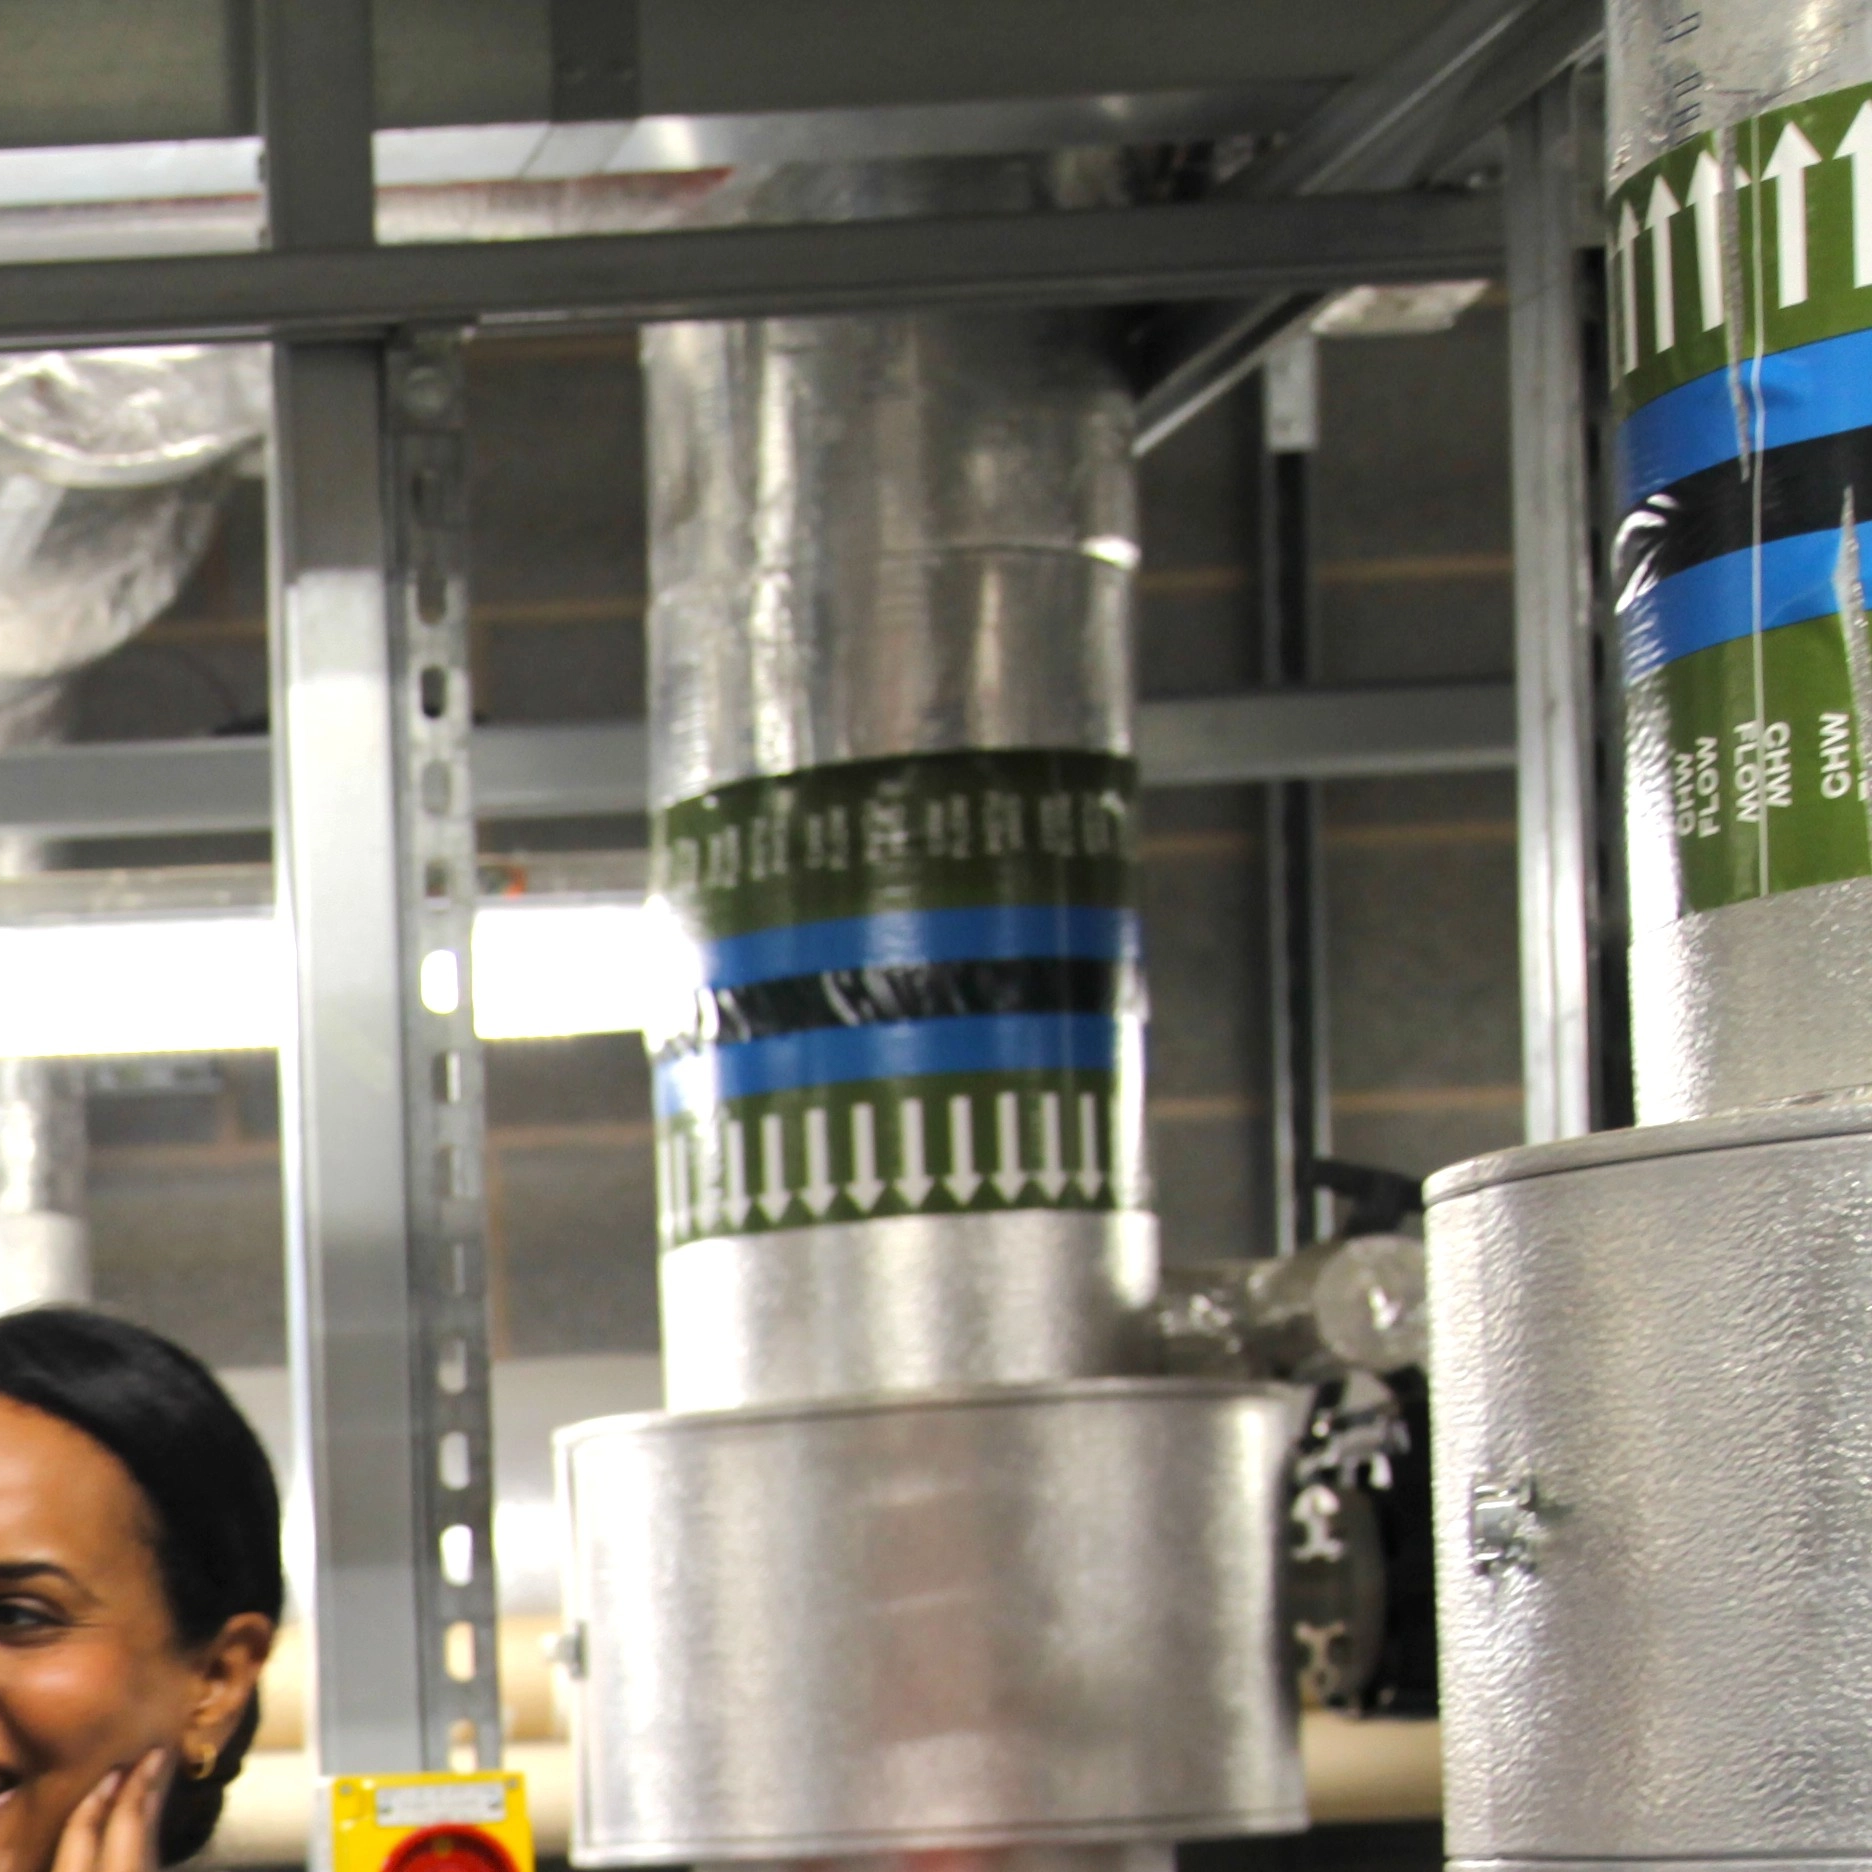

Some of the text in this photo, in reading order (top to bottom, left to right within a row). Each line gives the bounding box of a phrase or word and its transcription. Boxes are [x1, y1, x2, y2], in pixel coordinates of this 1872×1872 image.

[1675, 753, 1697, 837] CHW
[1695, 736, 1722, 839] FLOW
[1733, 719, 1761, 824] FLOW
[1763, 721, 1793, 808] CHW
[1819, 712, 1853, 800] CHW
